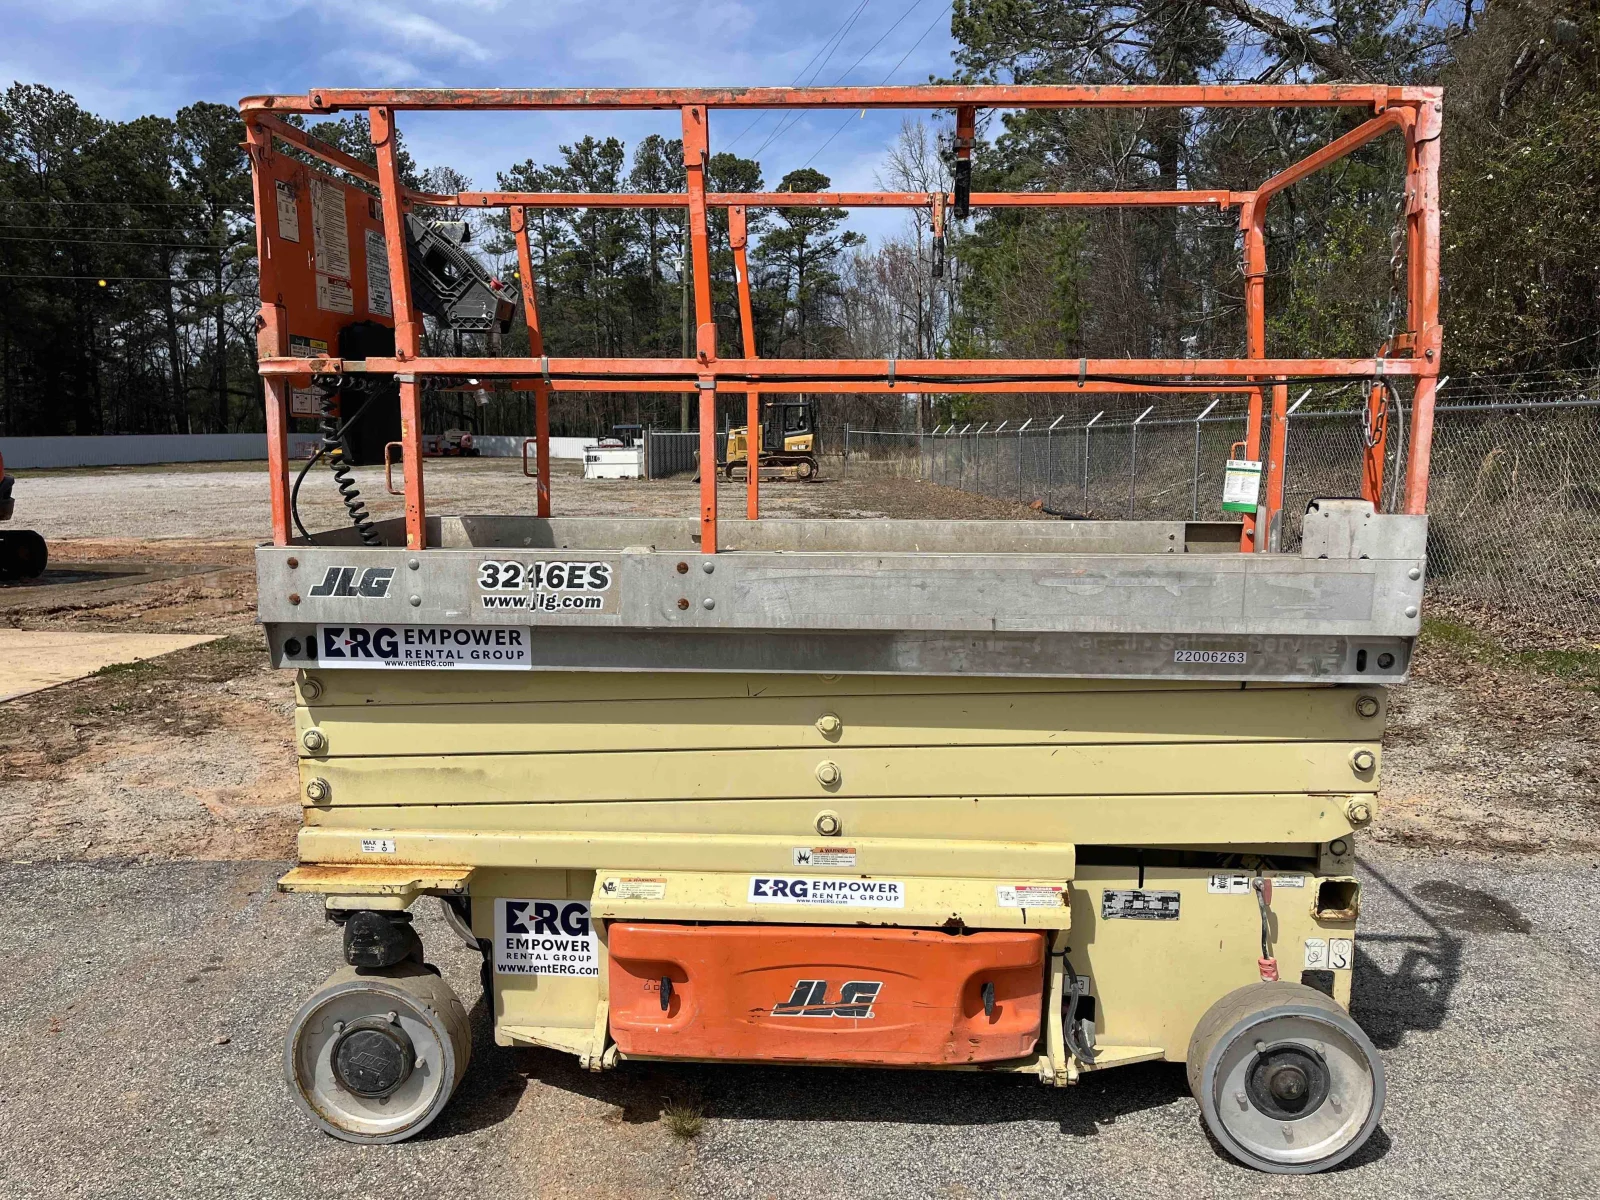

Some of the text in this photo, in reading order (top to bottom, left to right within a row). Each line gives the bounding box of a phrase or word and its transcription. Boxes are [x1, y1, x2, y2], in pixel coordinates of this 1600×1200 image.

[307, 566, 396, 598] JLG
[479, 562, 611, 590] 3246ES
[482, 593, 602, 611] www.jlg.com
[324, 627, 399, 658] ERG
[404, 628, 523, 646] EMPOWER
[384, 659, 455, 668] www.rentERG.com
[405, 649, 525, 660] RENTAL GROUP
[1176, 651, 1245, 663] 22006263
[753, 879, 808, 898] ERG
[812, 881, 898, 893] EMPOWER
[860, 894, 900, 902] GROUP
[506, 901, 589, 936] ERG
[506, 938, 591, 952] EMPOWER
[506, 952, 592, 962] RENTAL GROUP
[770, 979, 883, 1018] JLG
[349, 1051, 391, 1073] JLG
